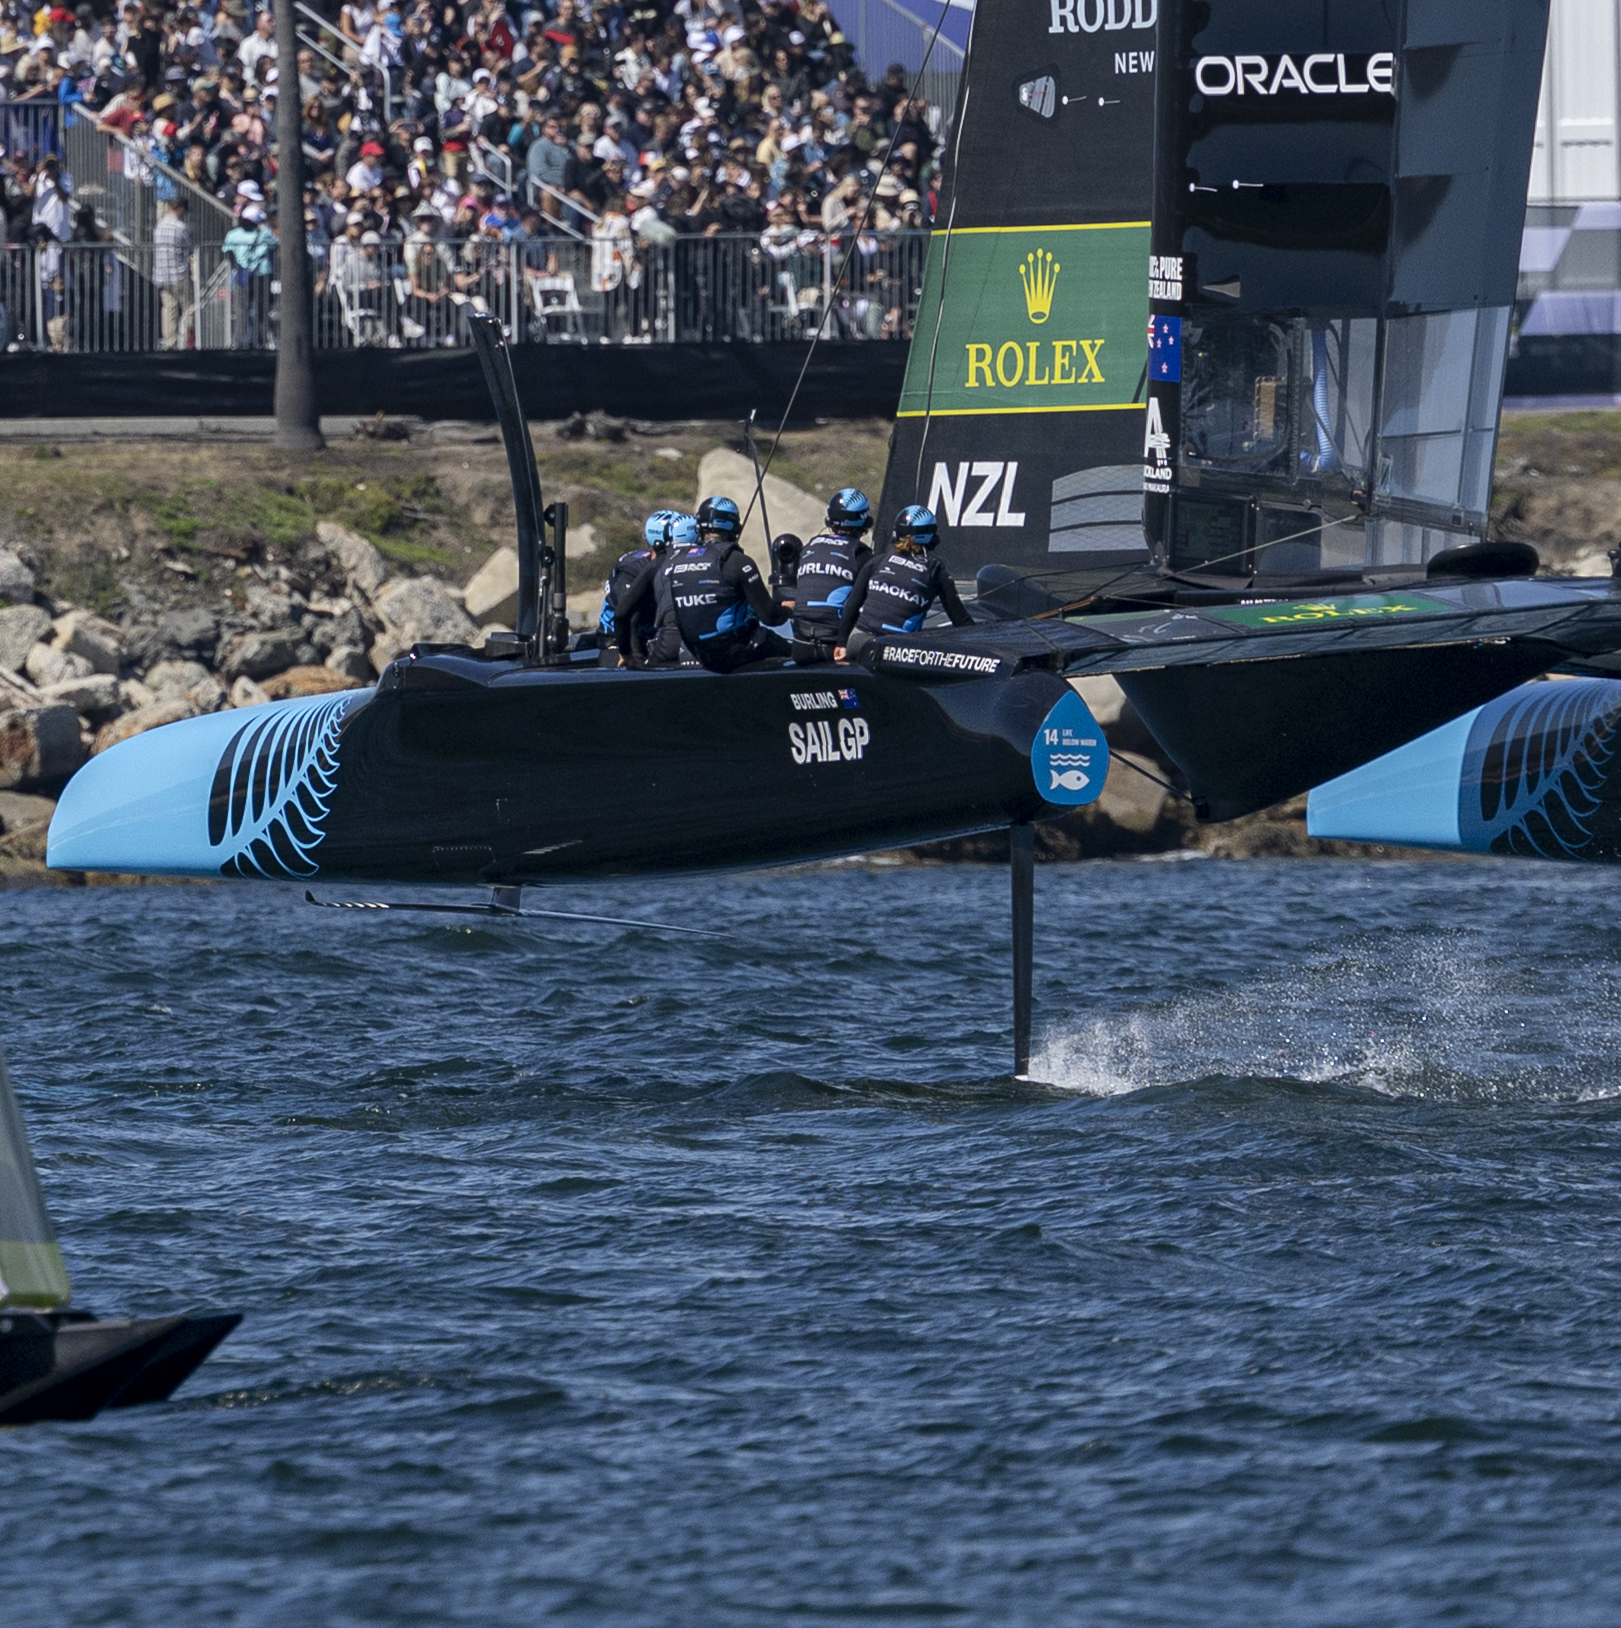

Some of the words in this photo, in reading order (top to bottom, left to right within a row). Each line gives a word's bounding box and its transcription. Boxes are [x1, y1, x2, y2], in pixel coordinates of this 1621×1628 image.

[1114, 50, 1155, 74] NEW
[1195, 52, 1394, 96] ORACLE
[965, 339, 1105, 388] ROLEX
[926, 461, 1026, 527] NZL
[797, 562, 854, 581] URLING
[675, 593, 718, 608] TUKE
[868, 579, 929, 608] MACKAY
[883, 646, 1001, 673] #RACEFORTHEFUTURE
[790, 691, 838, 710] BURLING
[1043, 728, 1059, 746] 14
